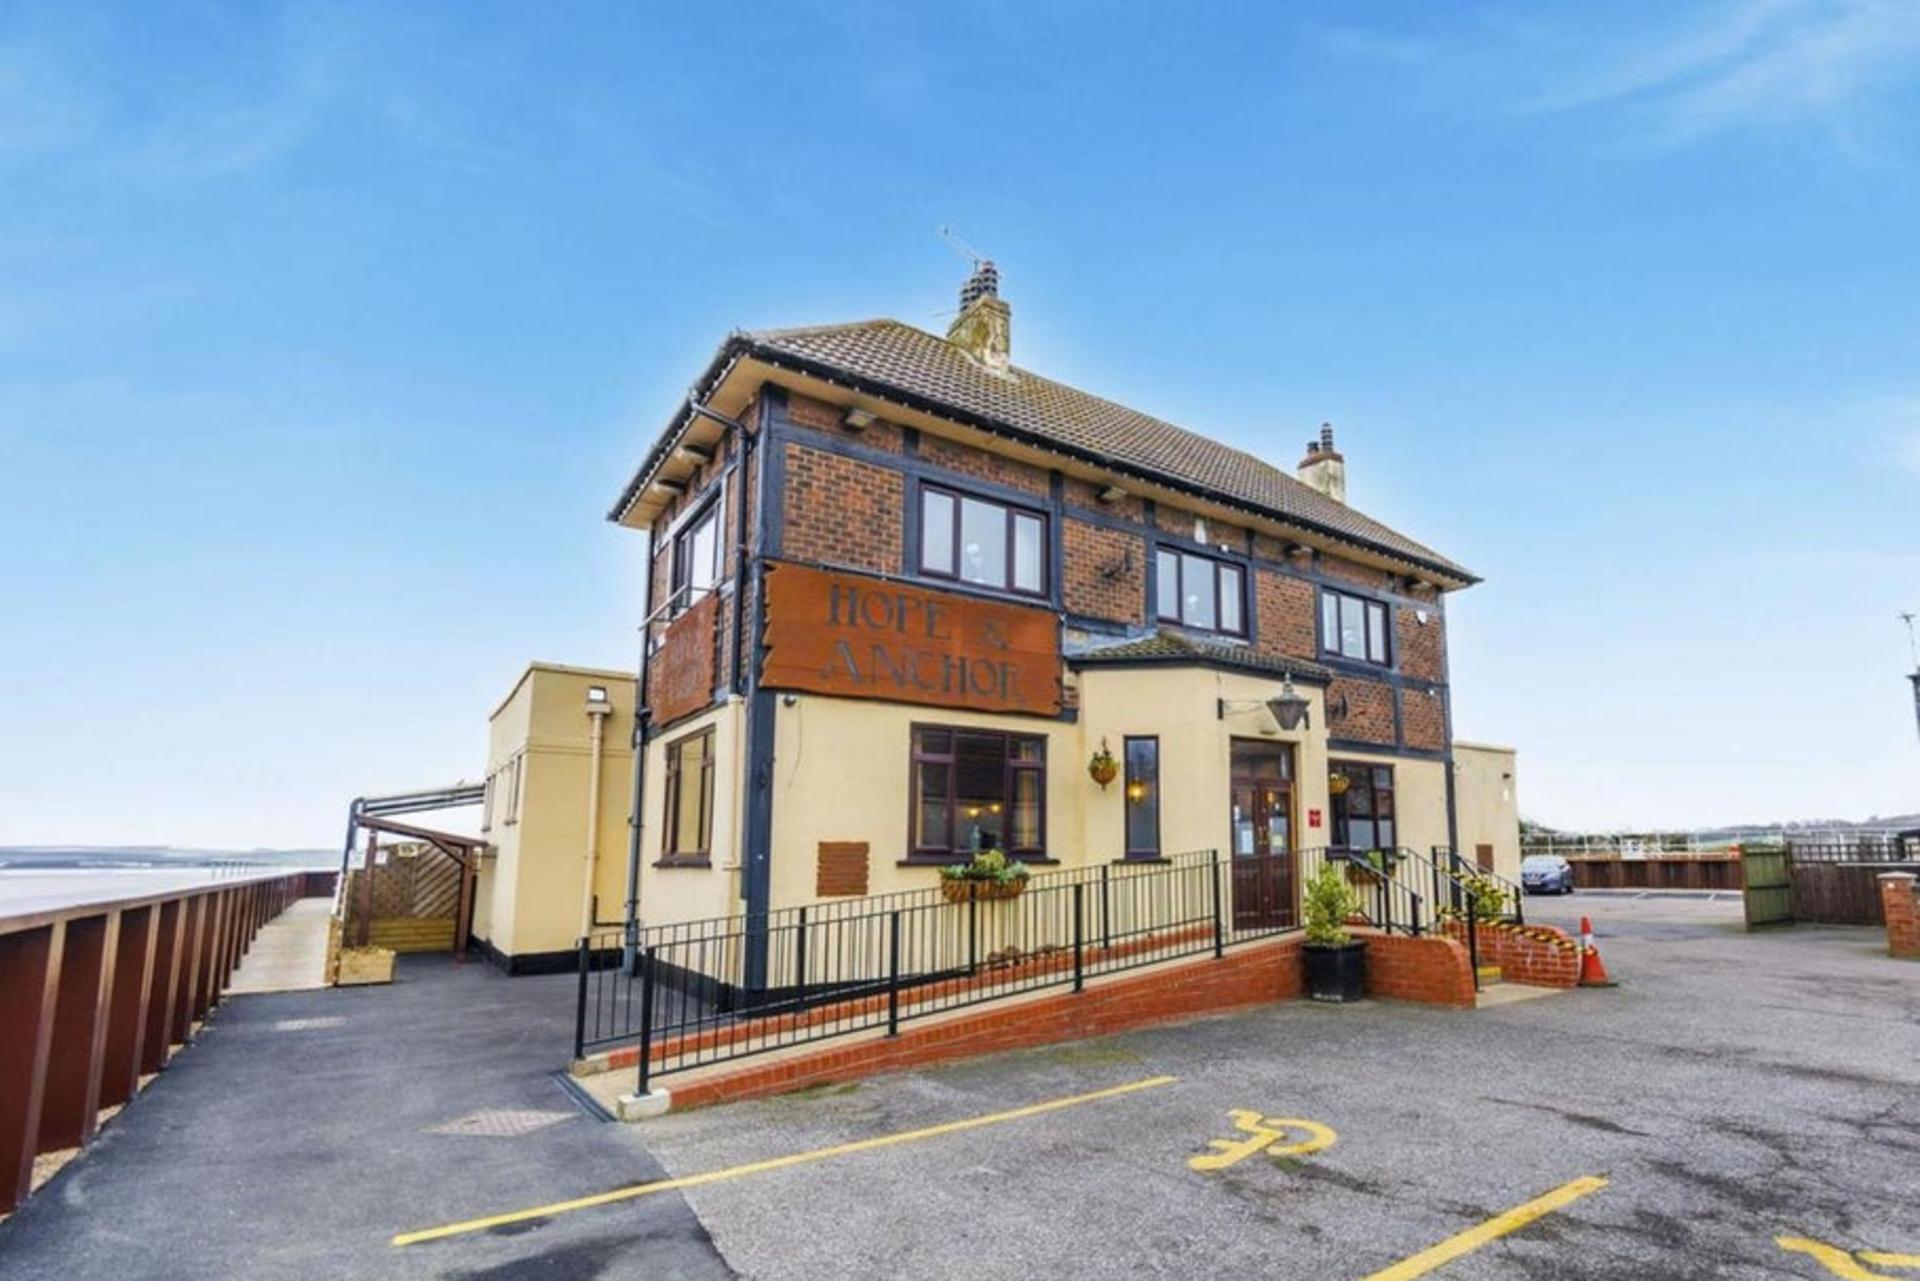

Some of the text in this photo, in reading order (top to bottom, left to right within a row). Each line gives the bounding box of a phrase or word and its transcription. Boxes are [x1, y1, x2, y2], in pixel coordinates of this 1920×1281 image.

[827, 582, 1012, 650] HOPE &
[818, 638, 1025, 701] ANCHOR
